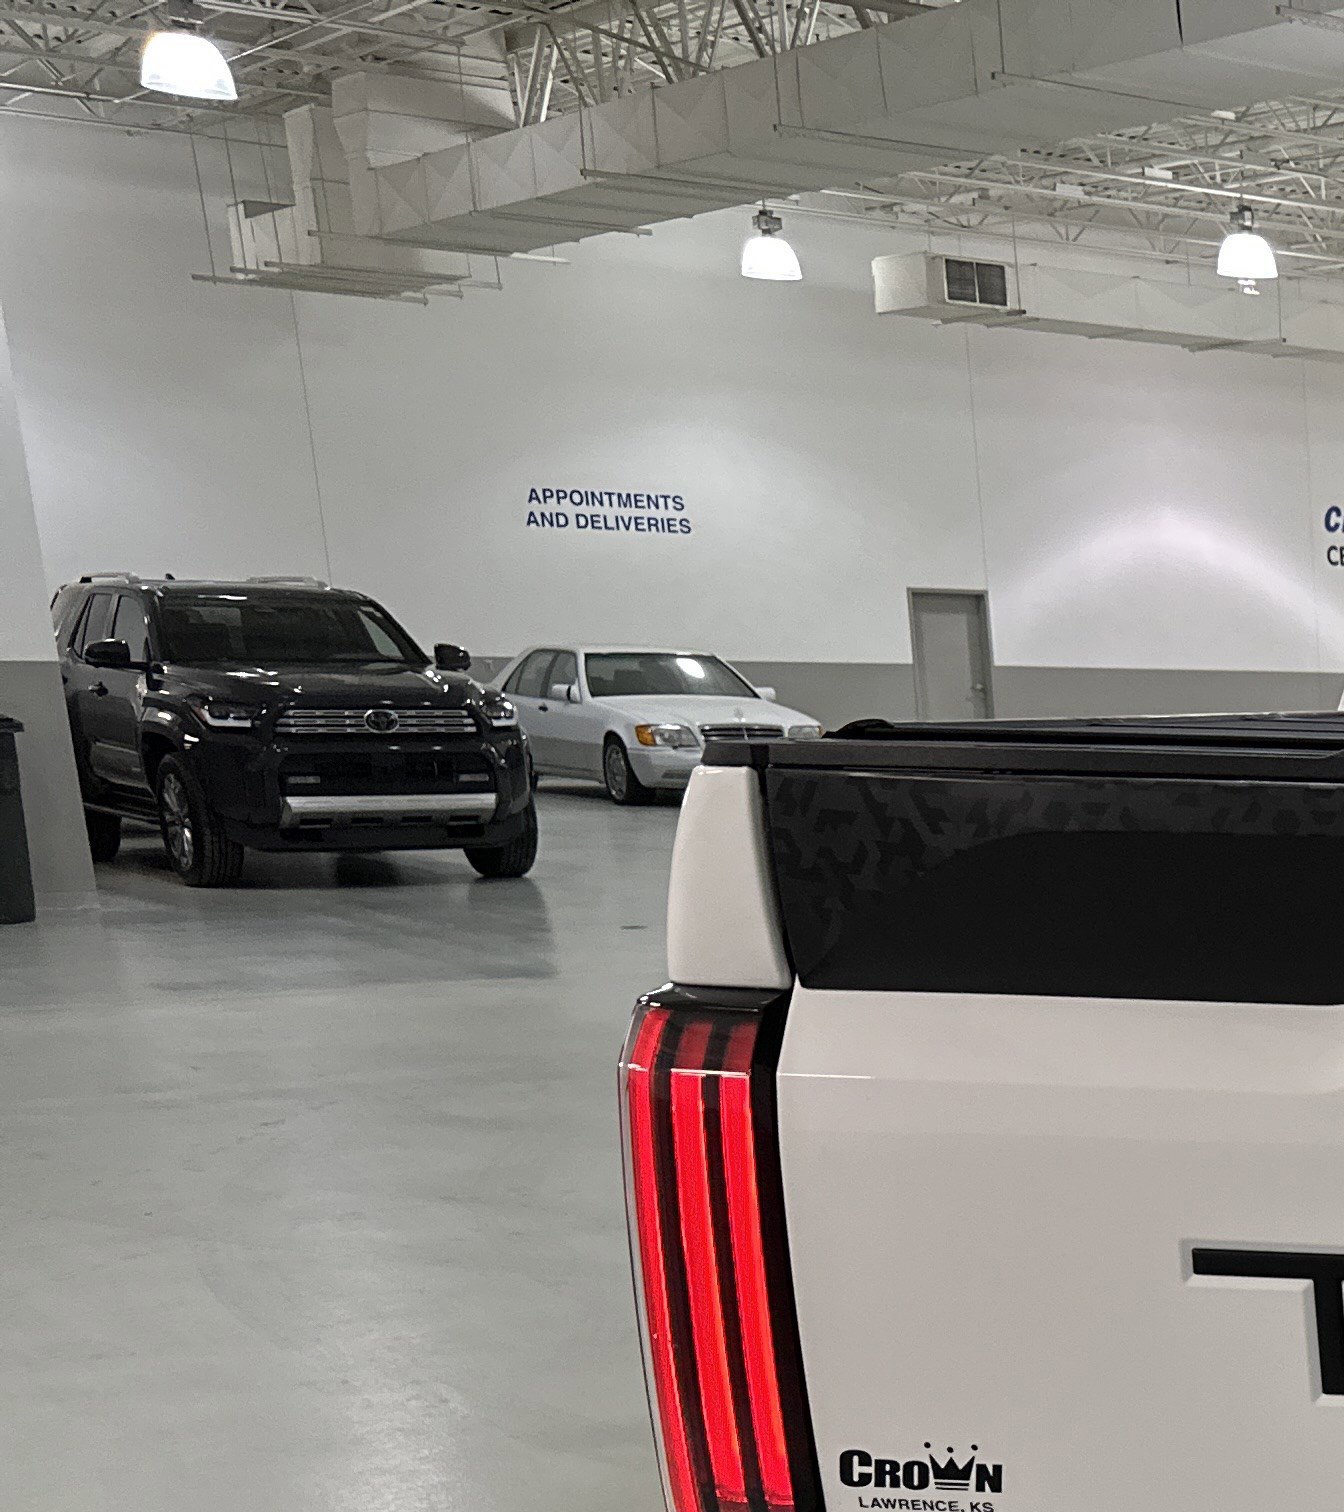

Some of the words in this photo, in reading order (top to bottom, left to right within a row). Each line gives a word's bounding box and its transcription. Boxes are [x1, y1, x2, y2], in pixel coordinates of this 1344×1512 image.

[527, 488, 685, 511] APPOINTMENTS
[526, 511, 569, 528] AND
[575, 513, 692, 534] DELIVERIES
